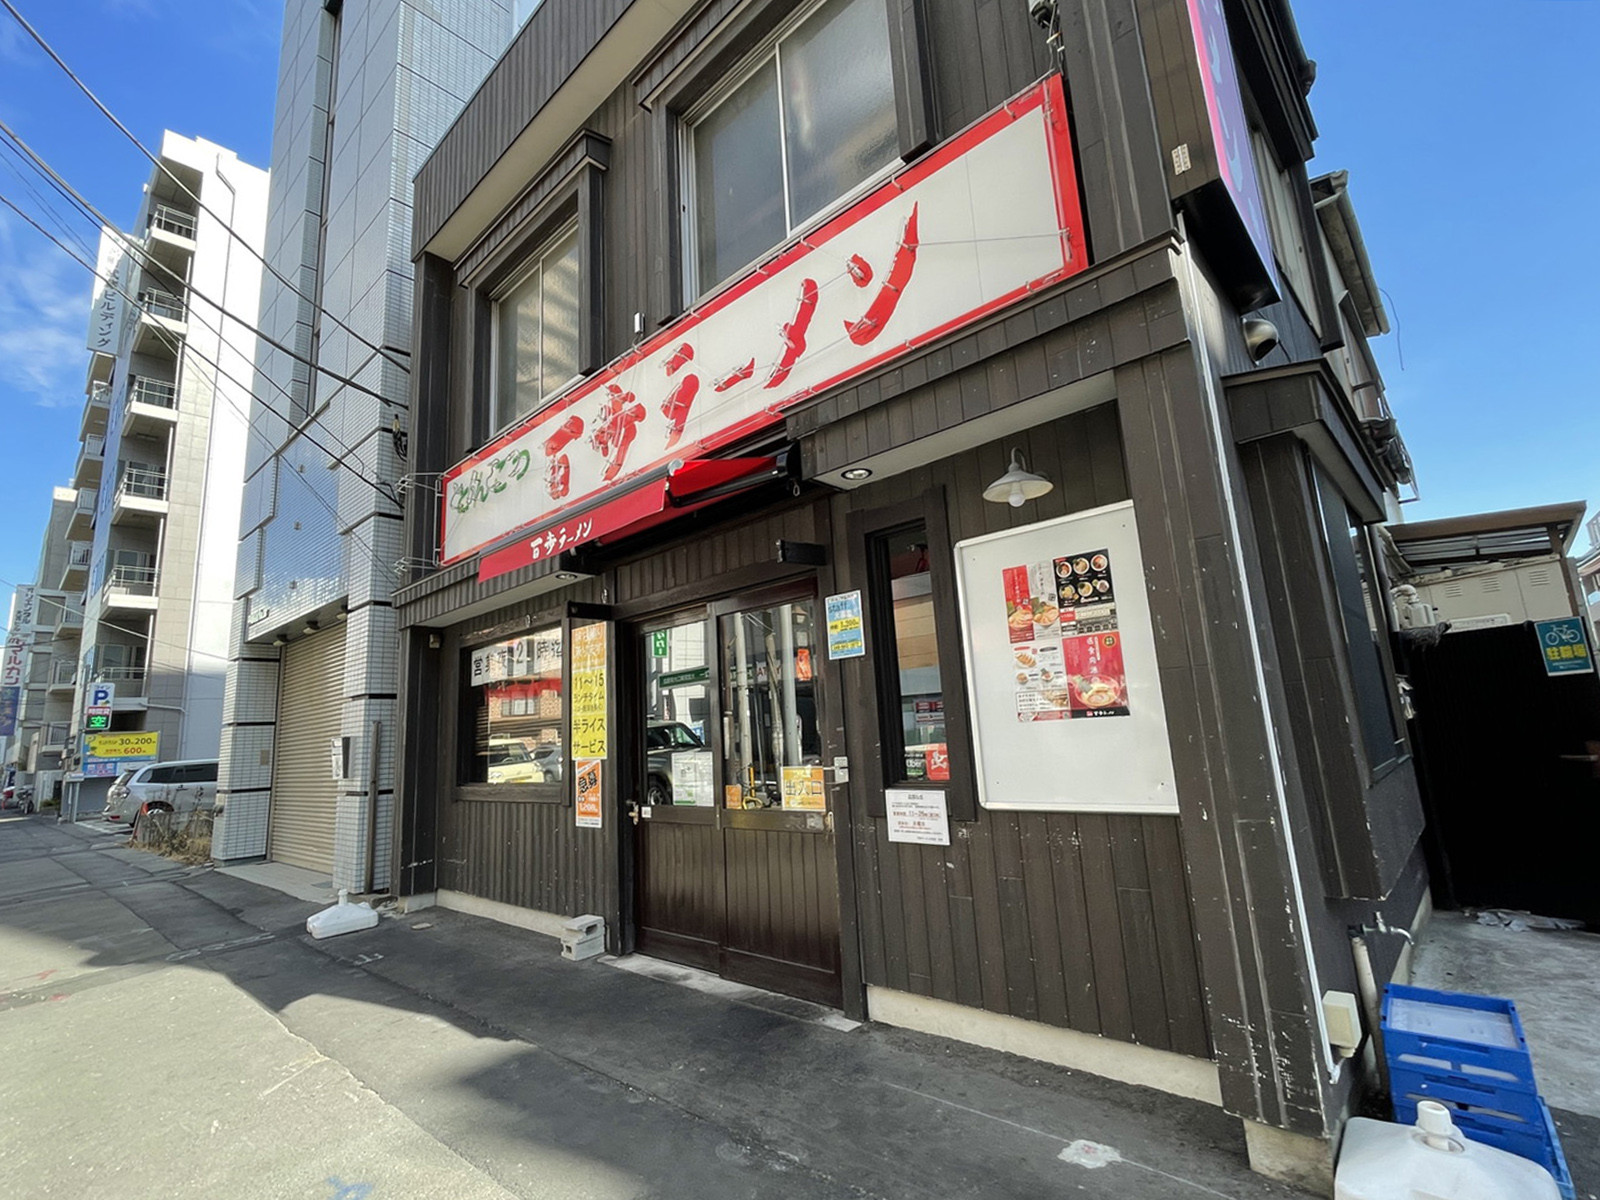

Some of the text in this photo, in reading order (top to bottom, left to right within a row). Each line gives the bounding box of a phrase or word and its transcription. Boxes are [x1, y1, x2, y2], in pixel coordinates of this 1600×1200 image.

[529, 516, 594, 560] 百歩ラーメン
[1546, 643, 1587, 661] 駐輪場
[93, 690, 108, 705] P
[89, 715, 107, 728] 空
[572, 716, 606, 735] 半ライス
[572, 738, 606, 755] サービス
[785, 779, 823, 797] 出入口
